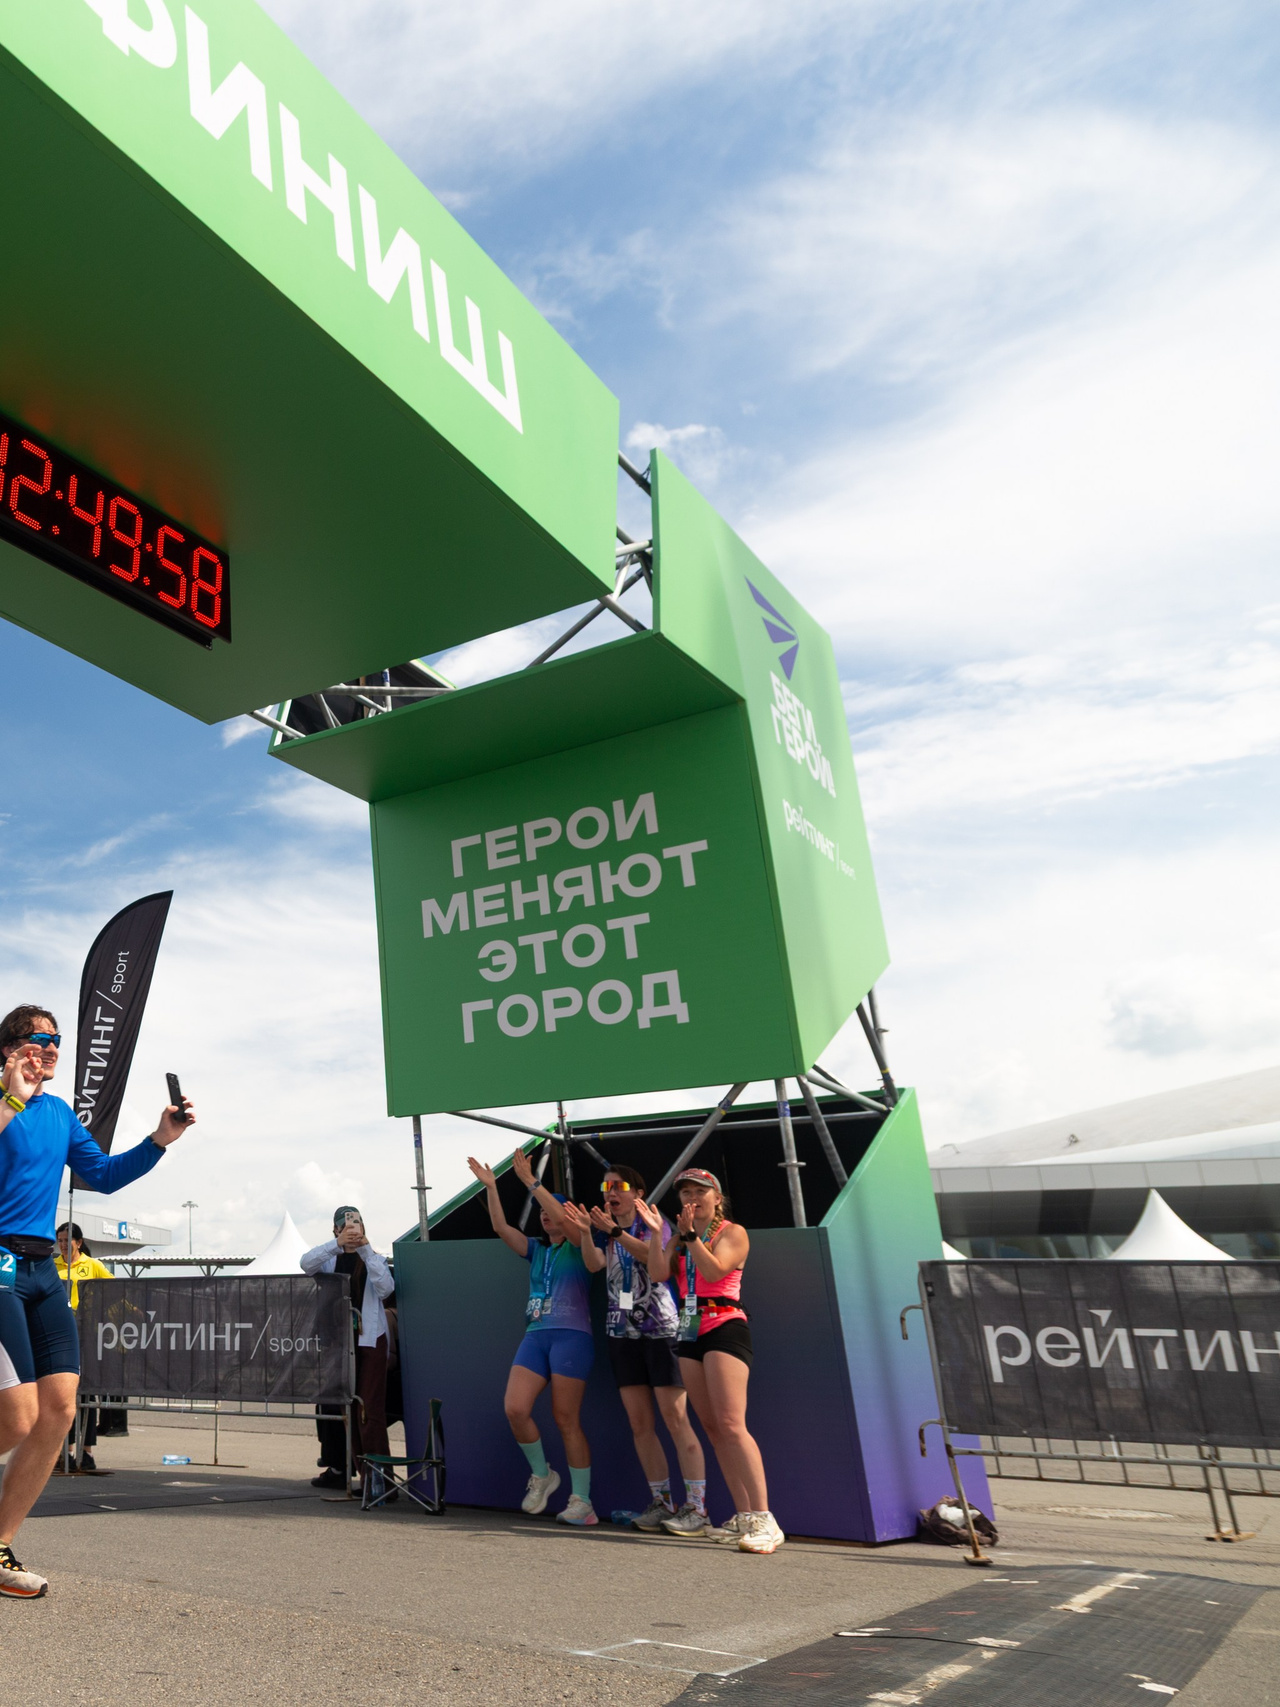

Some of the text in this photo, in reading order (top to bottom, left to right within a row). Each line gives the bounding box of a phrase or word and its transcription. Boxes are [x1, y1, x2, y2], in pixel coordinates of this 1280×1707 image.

[450, 791, 660, 878] ГЕРОИ
[421, 839, 709, 939] МЕНЯЮТ
[476, 912, 652, 983] ЭТОТ
[461, 969, 690, 1044] ГОРОД
[97, 1310, 322, 1364] рейтинг sport
